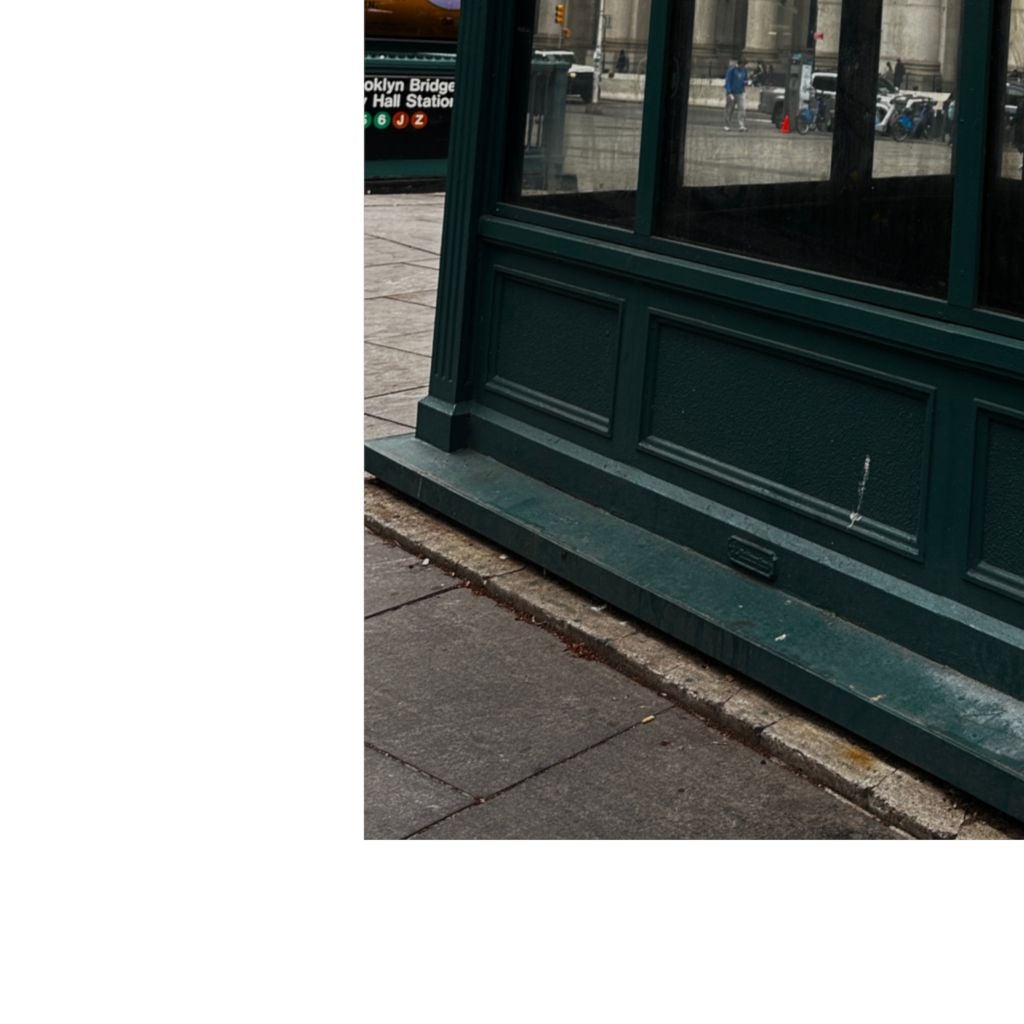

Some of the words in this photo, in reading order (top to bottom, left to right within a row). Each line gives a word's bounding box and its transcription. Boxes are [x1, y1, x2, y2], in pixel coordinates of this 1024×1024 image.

[409, 78, 456, 95] Bridge
[372, 93, 401, 108] Hall
[377, 113, 387, 126] 6
[396, 113, 405, 126] J
[414, 114, 424, 126] Z
